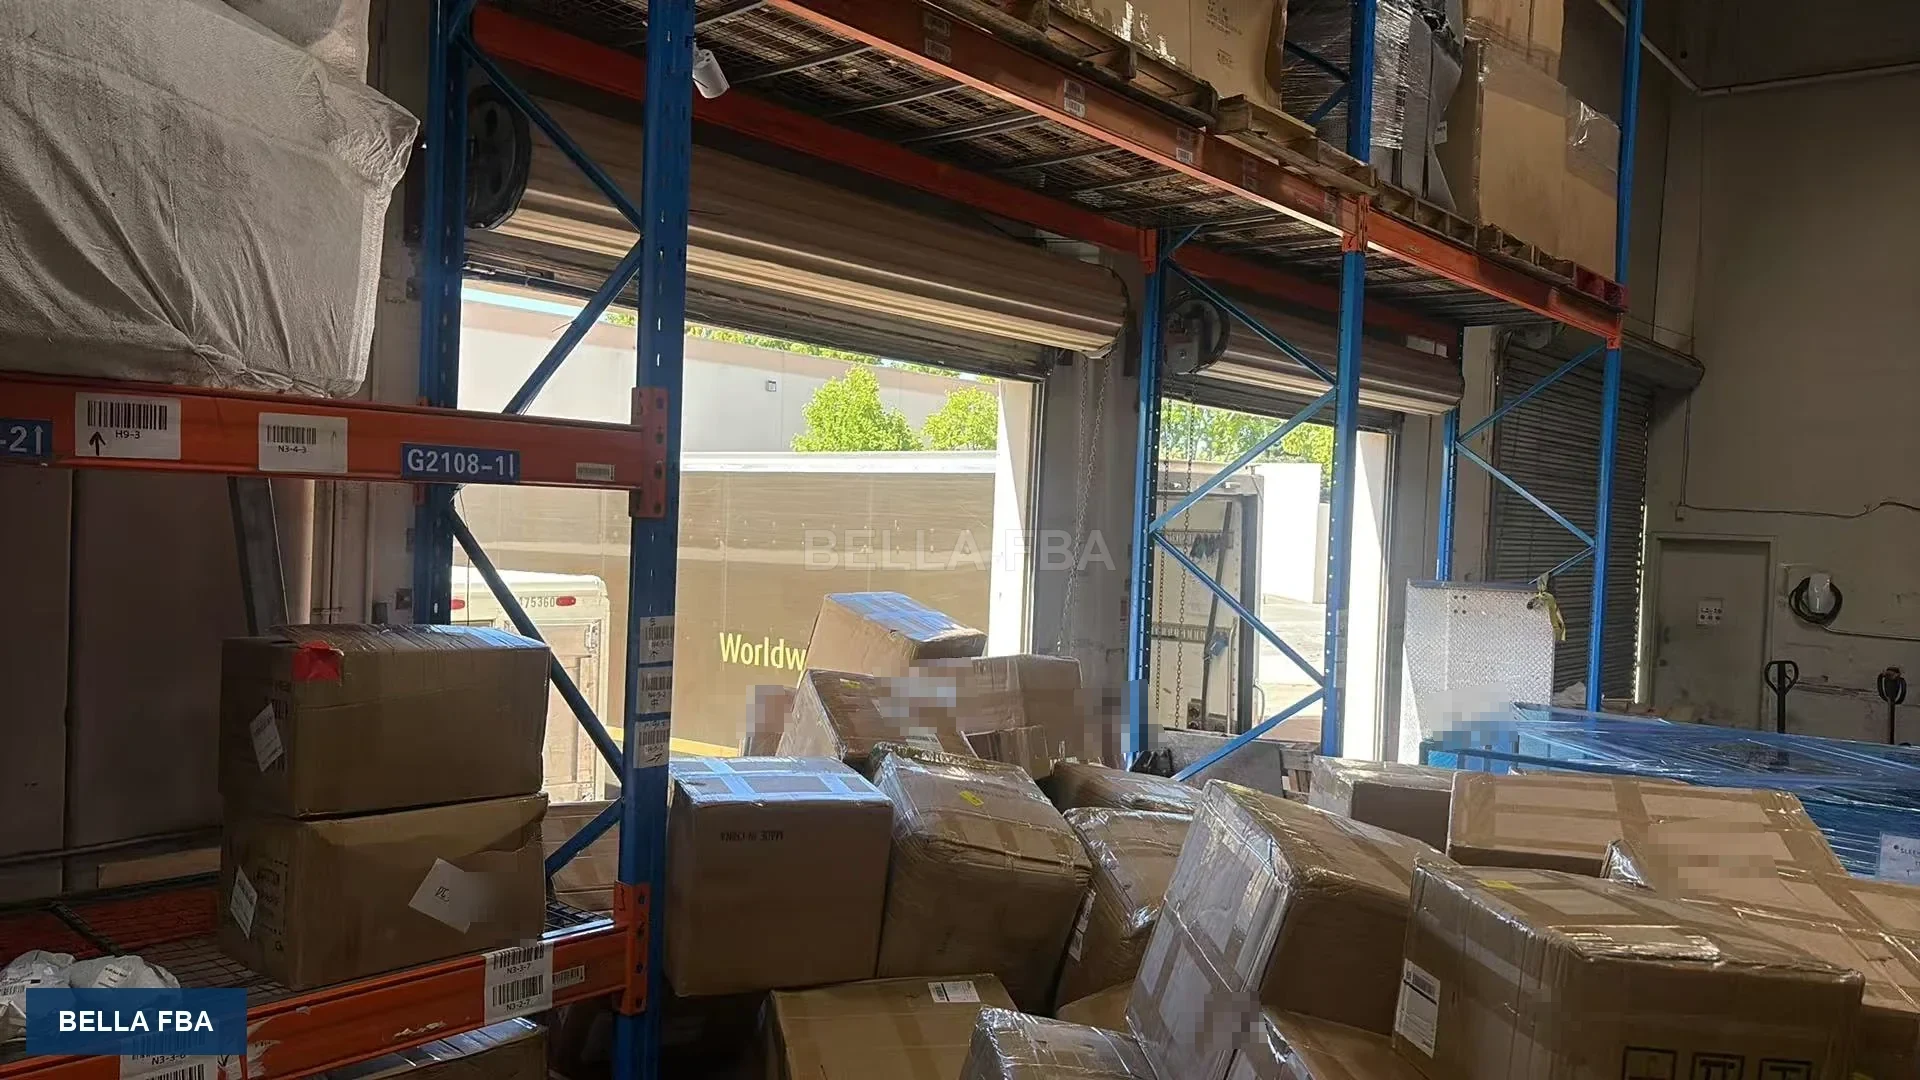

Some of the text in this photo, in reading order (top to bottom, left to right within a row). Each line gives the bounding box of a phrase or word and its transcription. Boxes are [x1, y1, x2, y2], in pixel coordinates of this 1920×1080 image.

[115, 430, 141, 439] H9-3
[407, 449, 504, 476] G2108-1
[506, 963, 531, 974] N3-3-7
[506, 999, 530, 1011] N3-2-7
